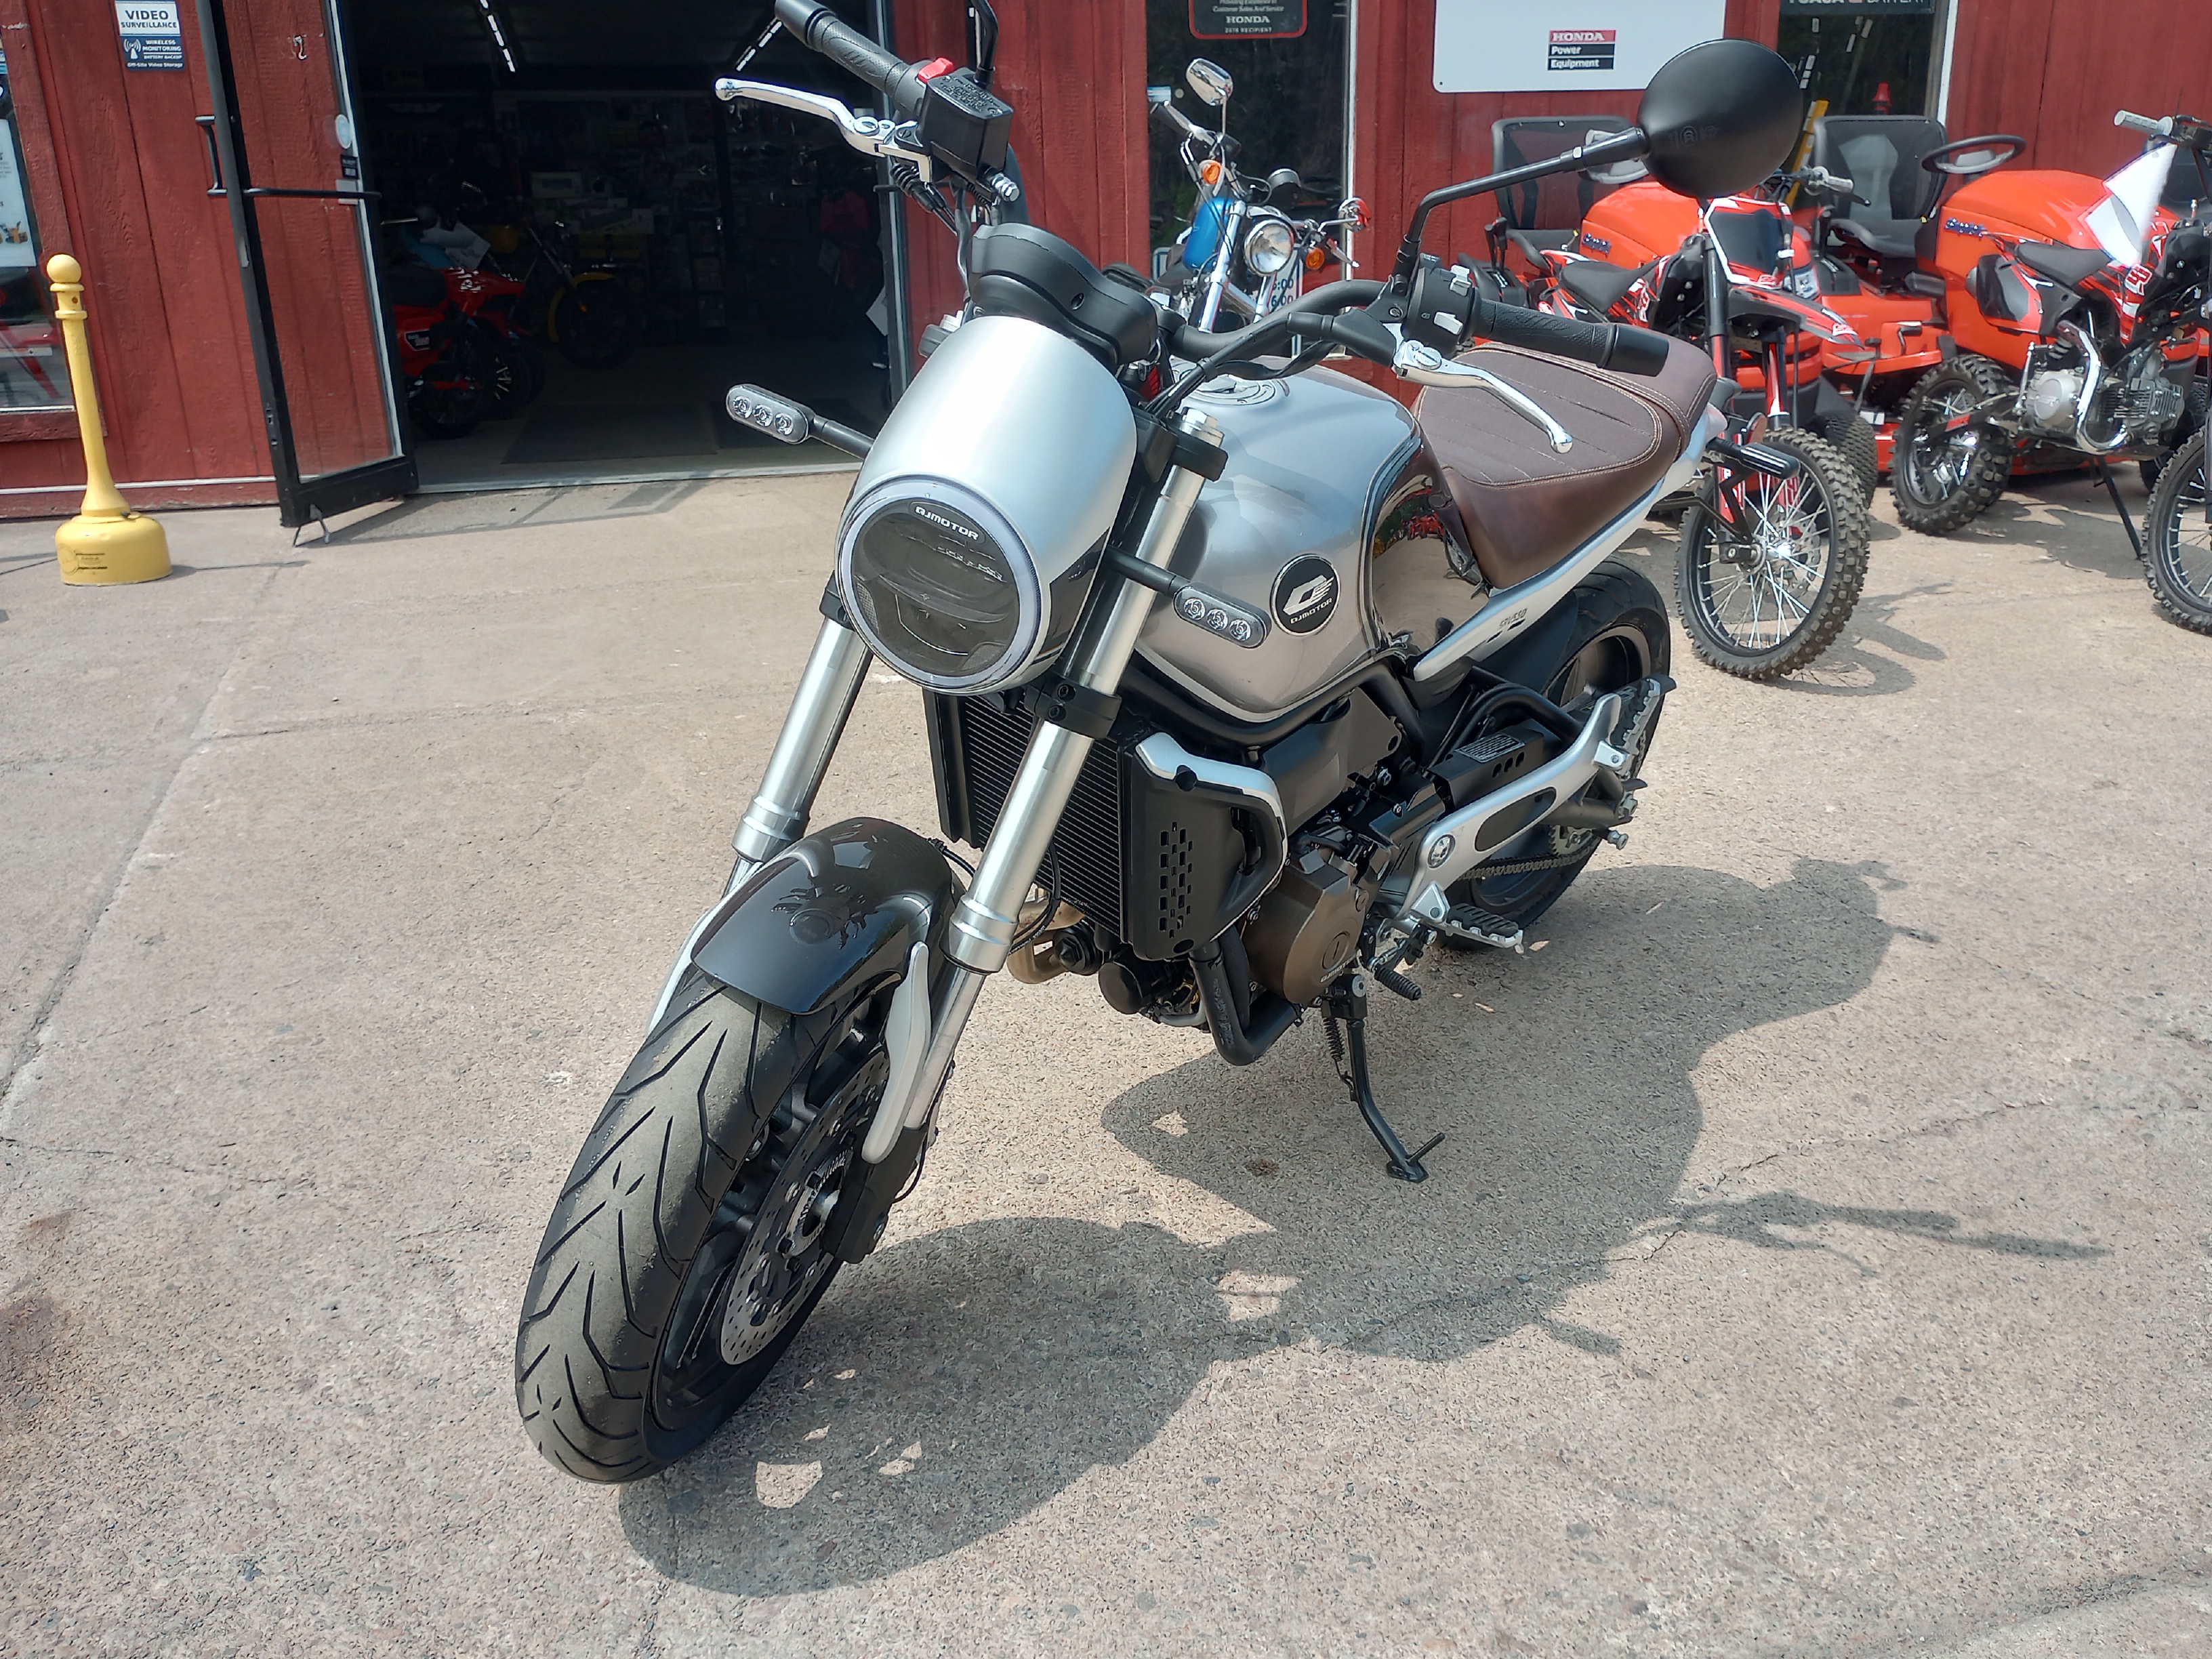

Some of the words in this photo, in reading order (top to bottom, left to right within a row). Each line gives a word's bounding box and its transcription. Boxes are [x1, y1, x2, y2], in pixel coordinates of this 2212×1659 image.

[125, 9, 169, 20] VIDEO
[1225, 16, 1271, 24] HONDA
[1552, 32, 1605, 41] HONDA
[1551, 45, 1582, 55] Power
[1551, 59, 1600, 69] Equipment
[1271, 295, 1294, 307] 600
[915, 506, 979, 541] QJMOTOR
[1290, 597, 1333, 624] QJMOTOR
